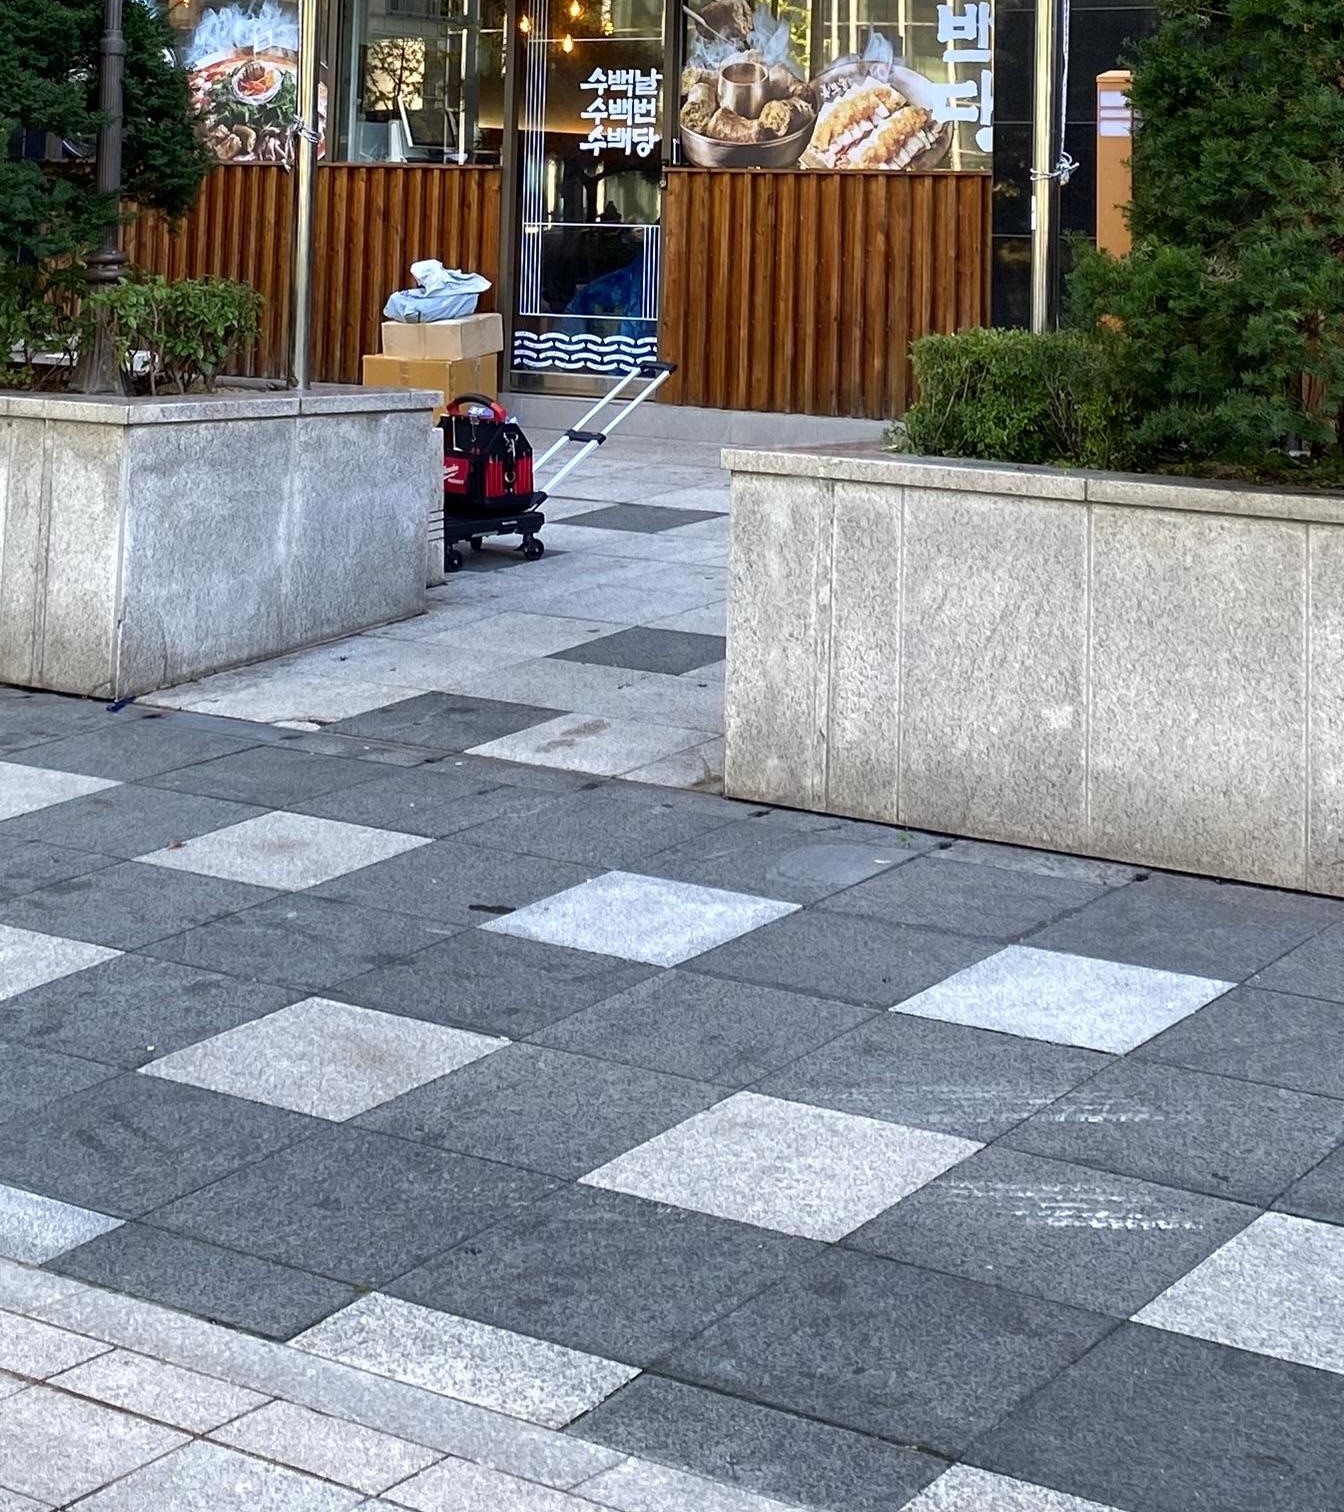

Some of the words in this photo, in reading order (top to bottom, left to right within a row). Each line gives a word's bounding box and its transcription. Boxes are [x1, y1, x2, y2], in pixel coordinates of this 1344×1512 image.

[579, 67, 664, 98] 수백날
[580, 97, 657, 126] 수백번
[579, 124, 663, 158] 수백당
